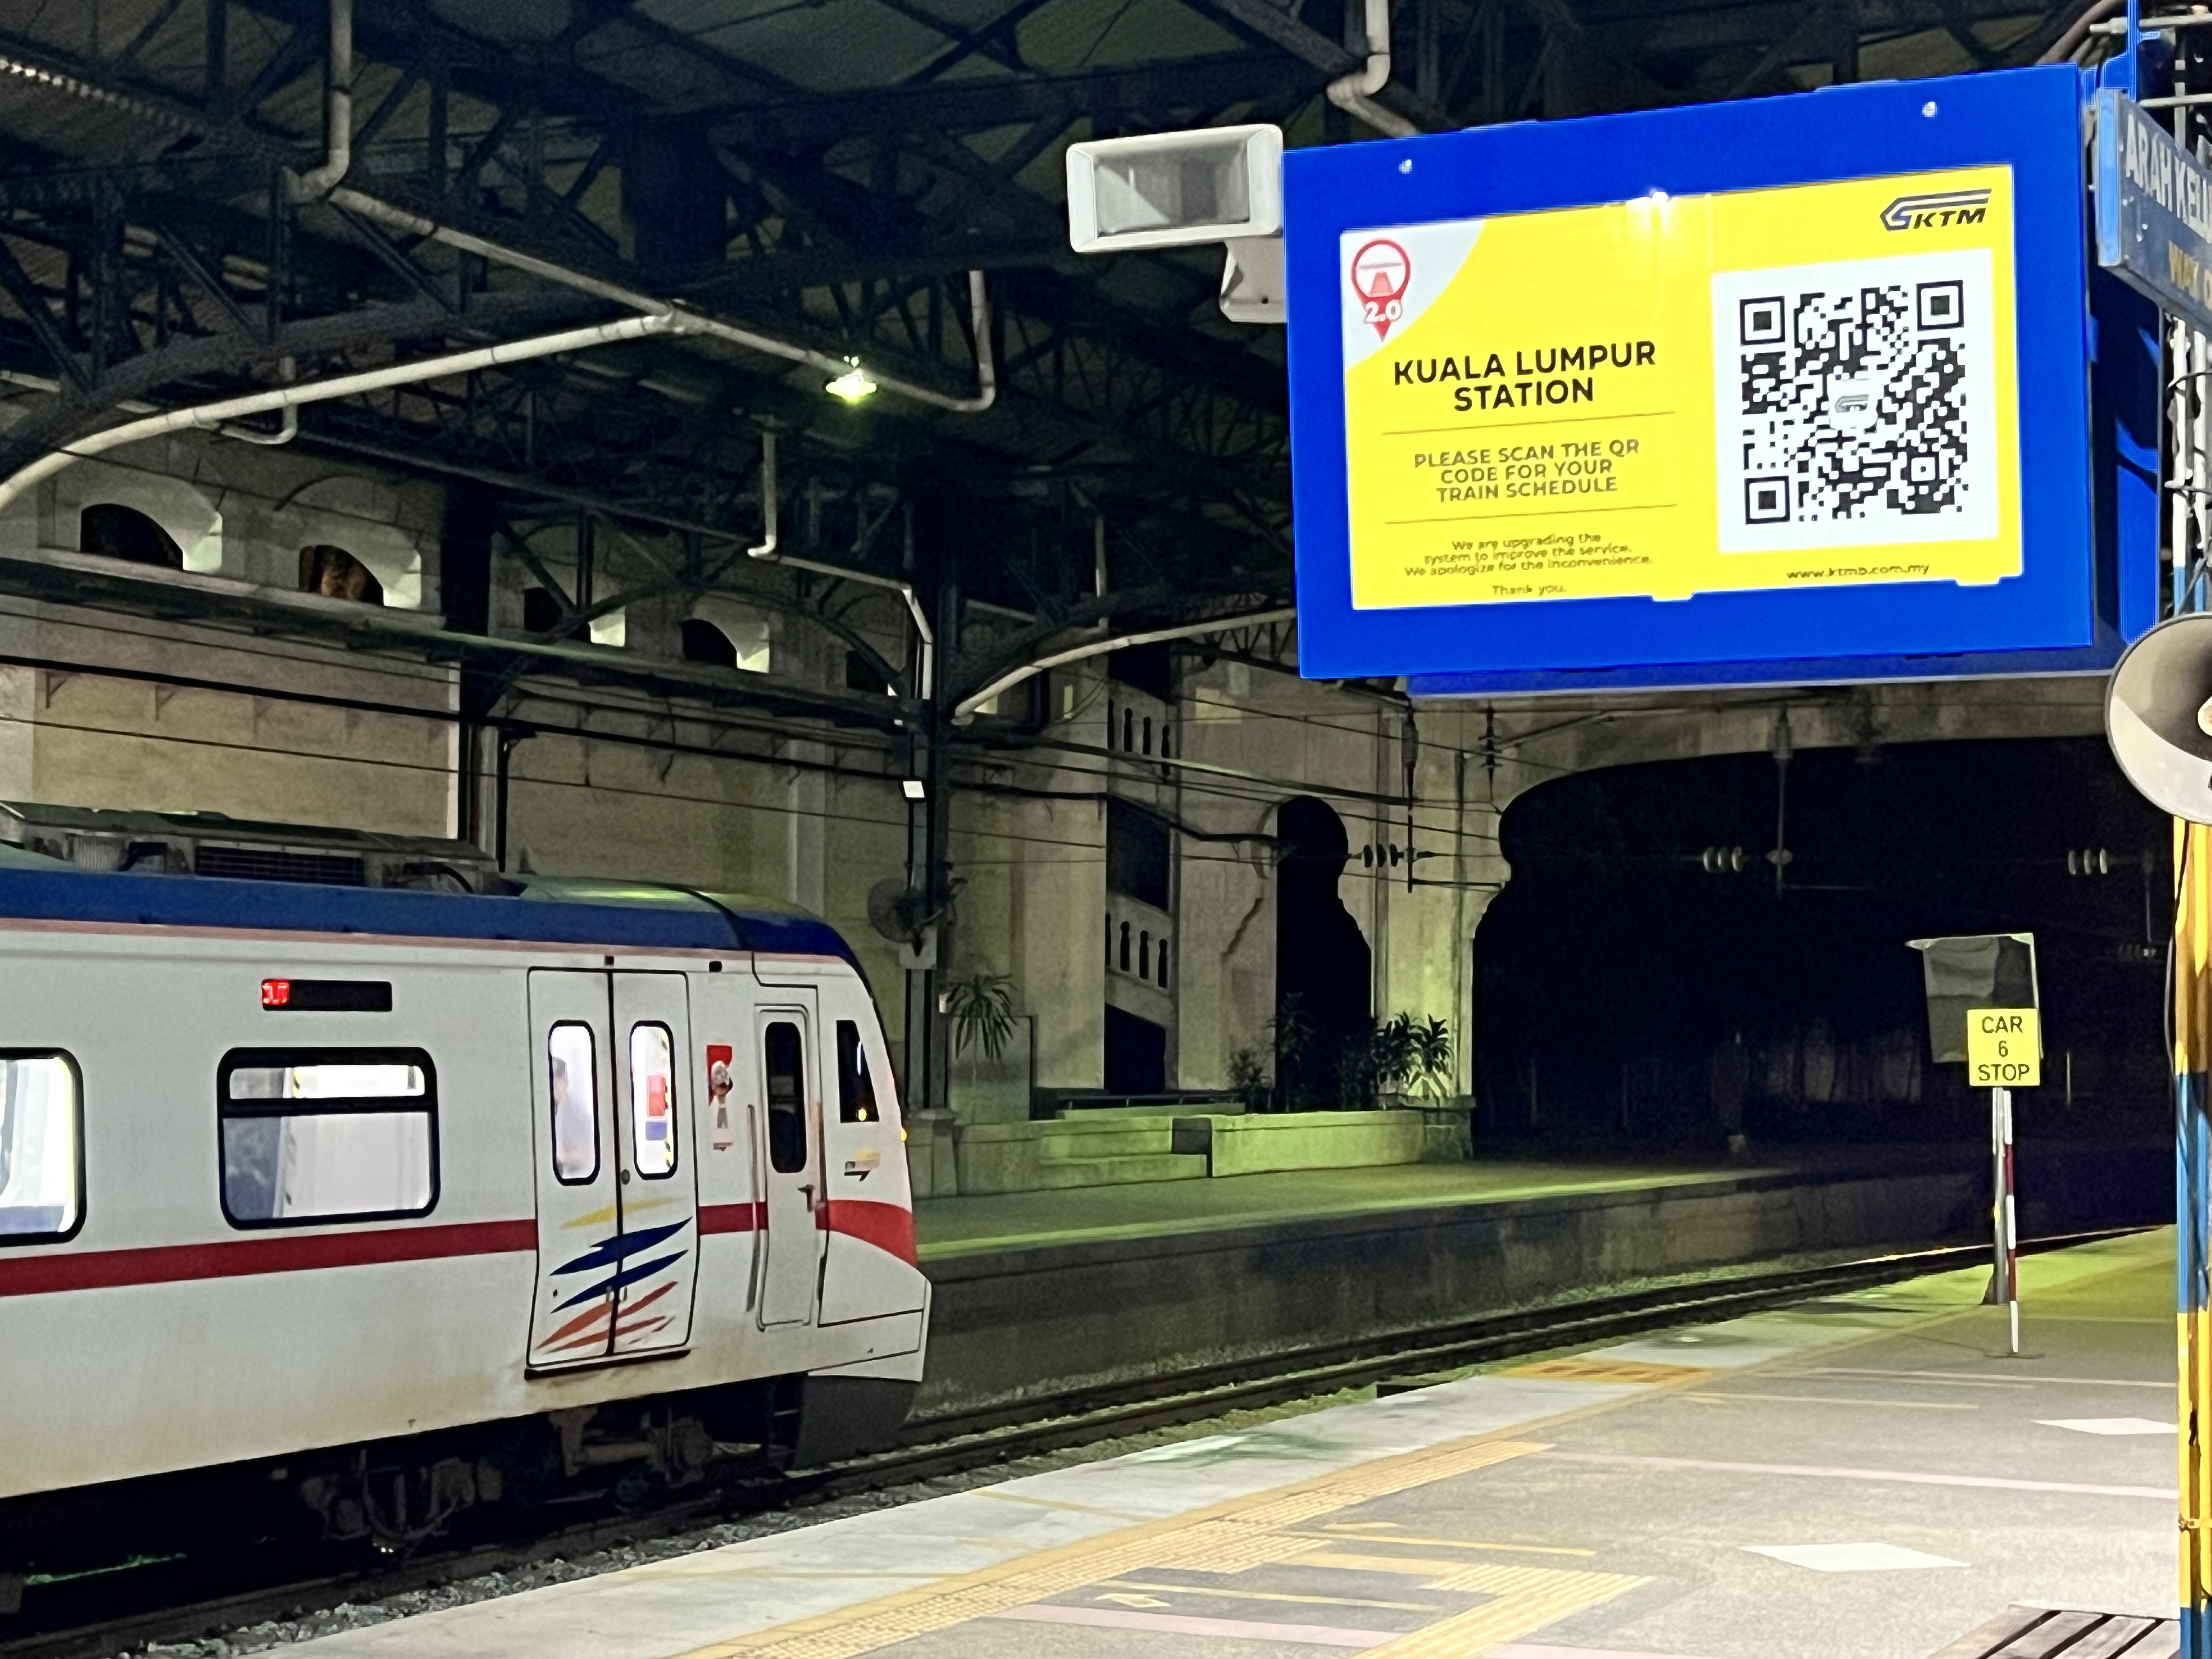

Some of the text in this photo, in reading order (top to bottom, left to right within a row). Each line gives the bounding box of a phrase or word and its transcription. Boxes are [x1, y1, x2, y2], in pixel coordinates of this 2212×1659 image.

[2126, 114, 2172, 212] ARAH
[1913, 207, 1987, 229] KTM
[1364, 300, 1402, 324] 2.0
[1395, 341, 1656, 386] KUALA LUMPUR
[1454, 377, 1593, 411] STATION
[1414, 438, 1639, 468] PLEASE SCAN THE QR
[1441, 459, 1612, 484] CODE FOR YOUR
[1436, 476, 1618, 503] TRAIN SCHEDULE
[1452, 533, 1601, 550] We are upgrading the
[1424, 552, 1471, 565] system
[1475, 551, 1488, 561] to
[1492, 548, 1548, 560] improve
[1552, 545, 1575, 556] the
[1404, 566, 1426, 576] We
[1430, 563, 1494, 576] apologize
[1498, 561, 1516, 572] for
[1521, 560, 1544, 570] the
[1492, 584, 1533, 596] Thank
[1981, 1015, 2023, 1034] CAR
[1997, 1040, 2009, 1058] 6
[1977, 1063, 2030, 1081] STOP
